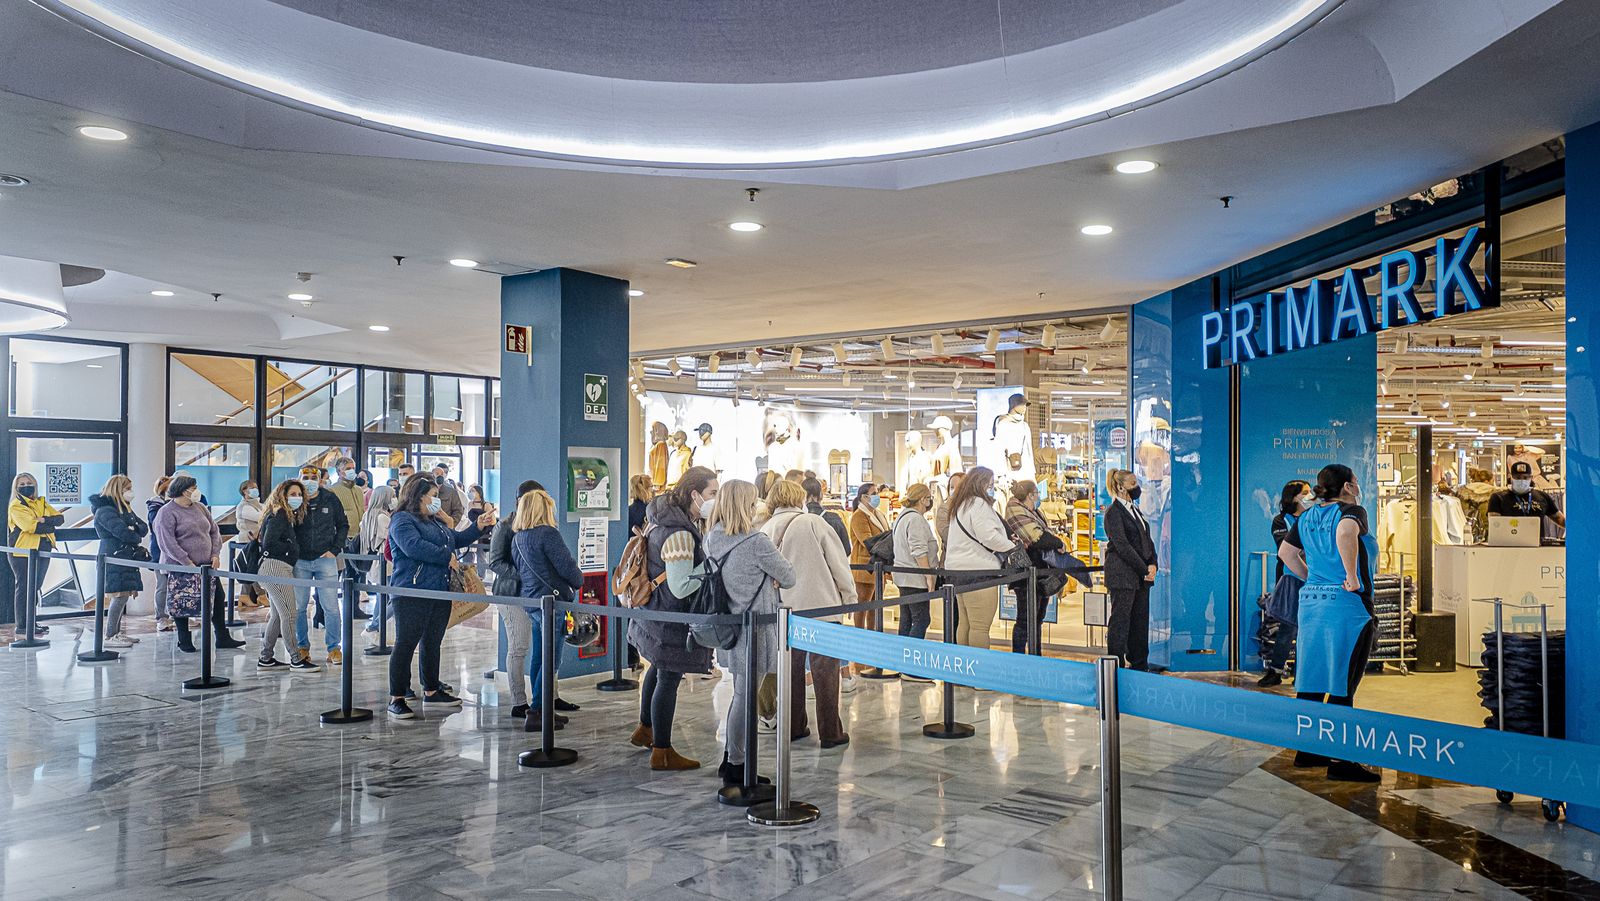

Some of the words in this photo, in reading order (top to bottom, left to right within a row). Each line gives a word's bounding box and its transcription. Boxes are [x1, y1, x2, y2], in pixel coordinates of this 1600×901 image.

[1202, 226, 1483, 370] PRIMARK
[586, 405, 606, 414] DEA
[1273, 438, 1345, 449] PRIMARK
